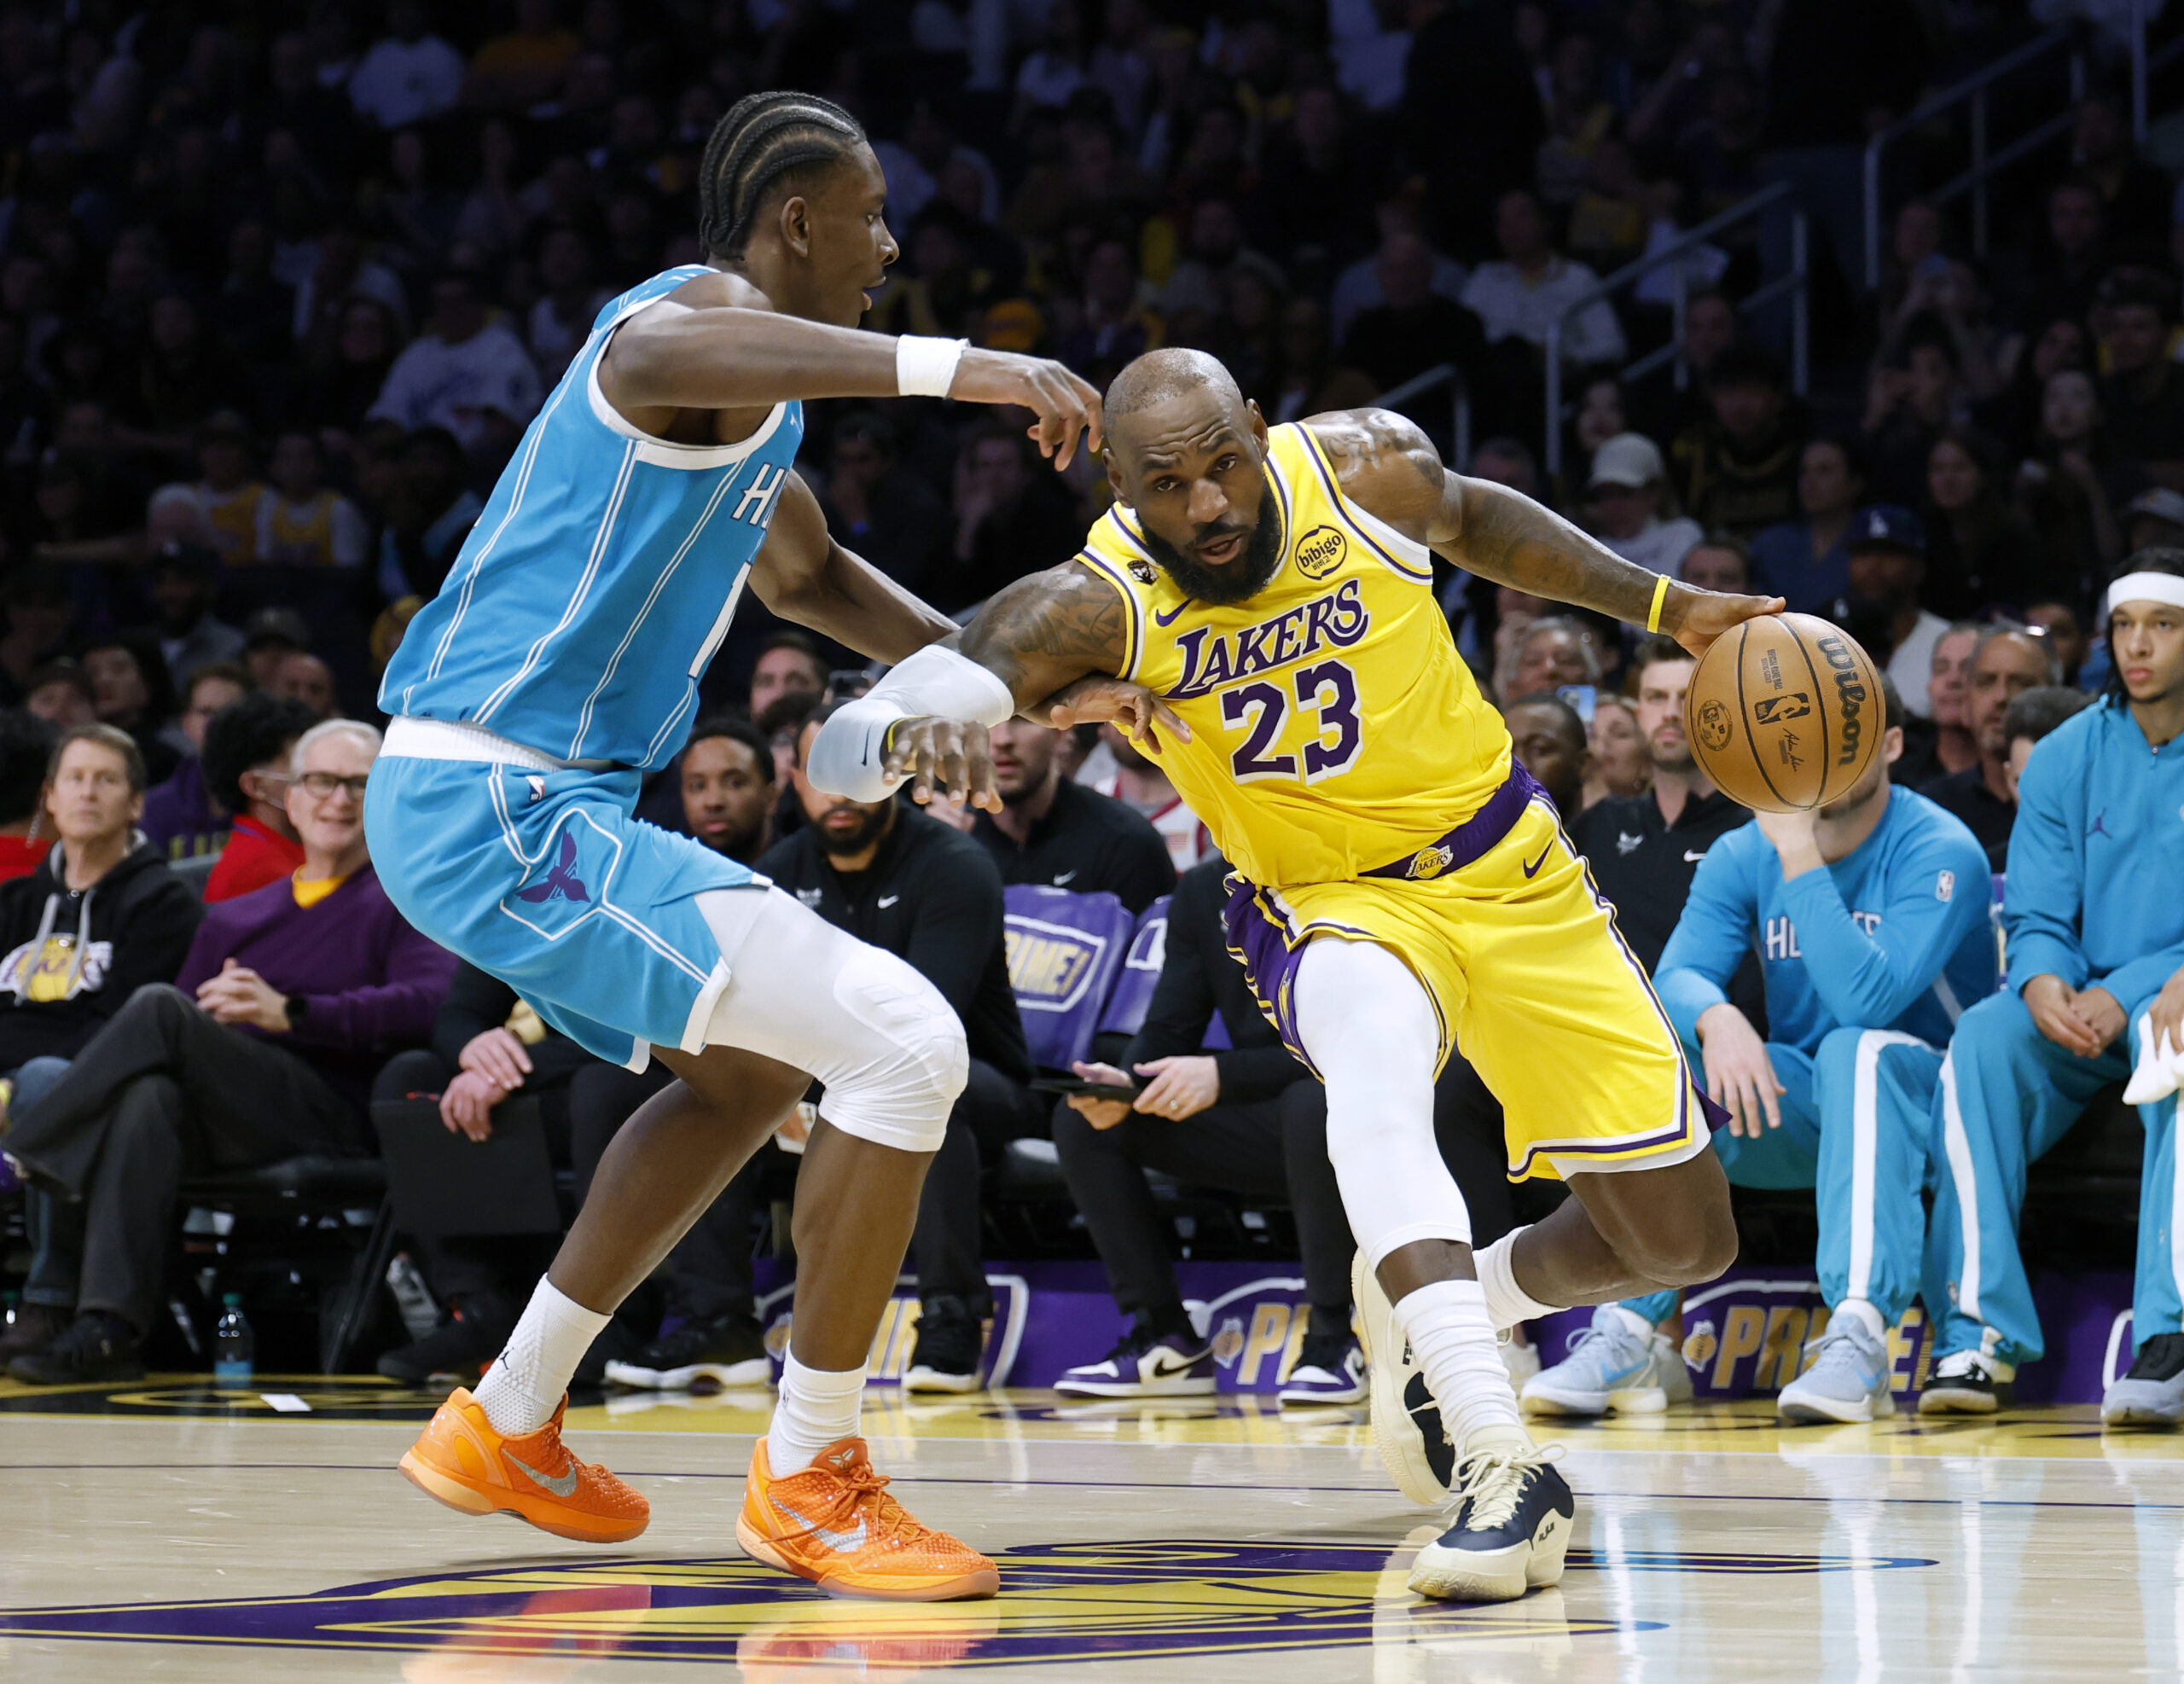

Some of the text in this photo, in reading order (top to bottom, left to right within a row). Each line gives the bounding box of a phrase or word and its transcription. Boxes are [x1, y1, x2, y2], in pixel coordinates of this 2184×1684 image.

[1298, 535, 1341, 568] bibigo
[1159, 578, 1371, 700] LAKERS
[1816, 635, 1866, 766] Wilson
[1218, 657, 1364, 787] 23
